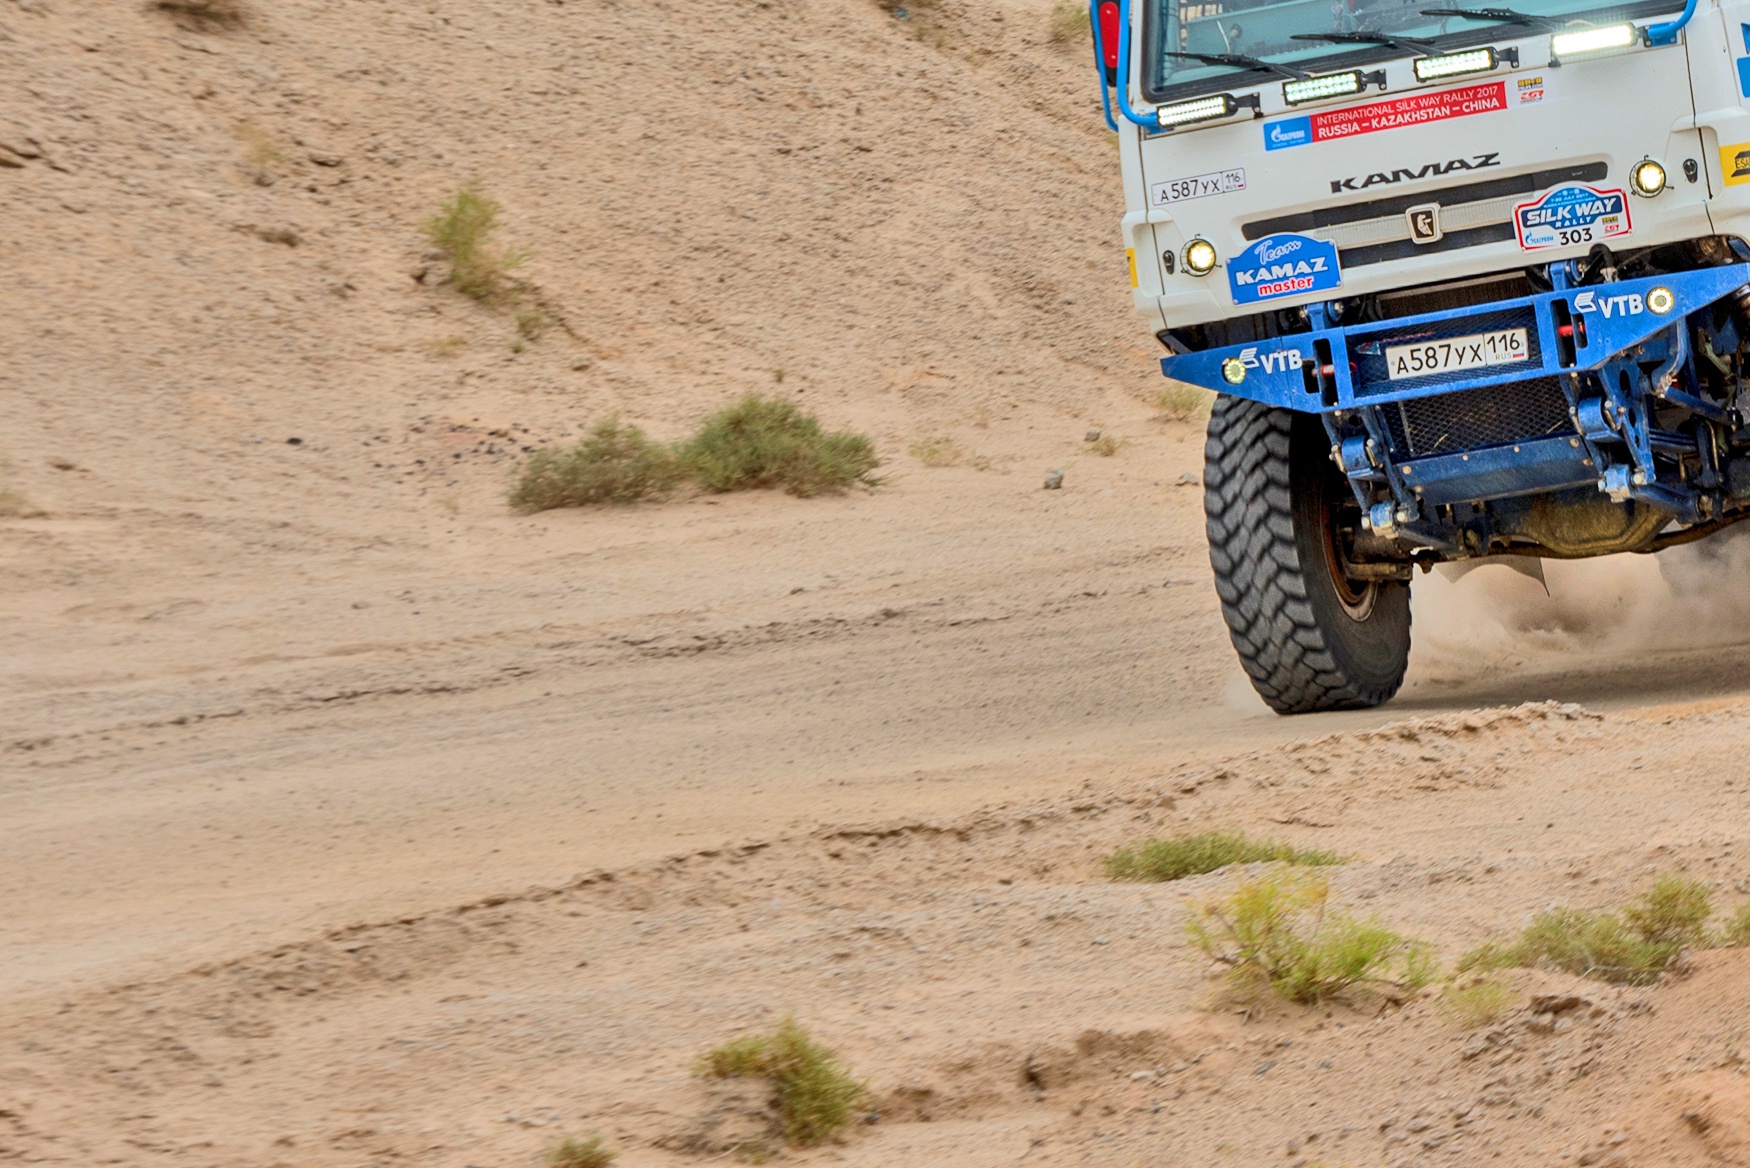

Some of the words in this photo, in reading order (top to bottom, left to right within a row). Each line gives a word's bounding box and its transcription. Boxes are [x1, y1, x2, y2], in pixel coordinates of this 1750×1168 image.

[1317, 104, 1395, 126] INTERNATIONAL
[1396, 99, 1418, 112] SILK
[1418, 95, 1441, 108] WAY
[1443, 89, 1475, 104] RALLY
[1476, 85, 1499, 98] 2017
[1318, 121, 1361, 139] RUSSIA
[1371, 105, 1451, 129] KAZAKHSTAN
[1461, 97, 1500, 113] CHINA
[1224, 173, 1241, 184] 116
[1330, 152, 1501, 194] KAMAZ
[1526, 204, 1573, 227] SILK
[1574, 197, 1617, 219] WAY
[1555, 216, 1593, 229] RALLY
[1558, 227, 1593, 246] 303
[1254, 239, 1302, 266] Team
[1236, 256, 1329, 287] KAMAZ
[1258, 275, 1314, 297] master
[1598, 293, 1644, 320] VTB
[1486, 332, 1521, 354] 116
[1259, 349, 1303, 374] VTB
[1495, 352, 1512, 361] RUS
